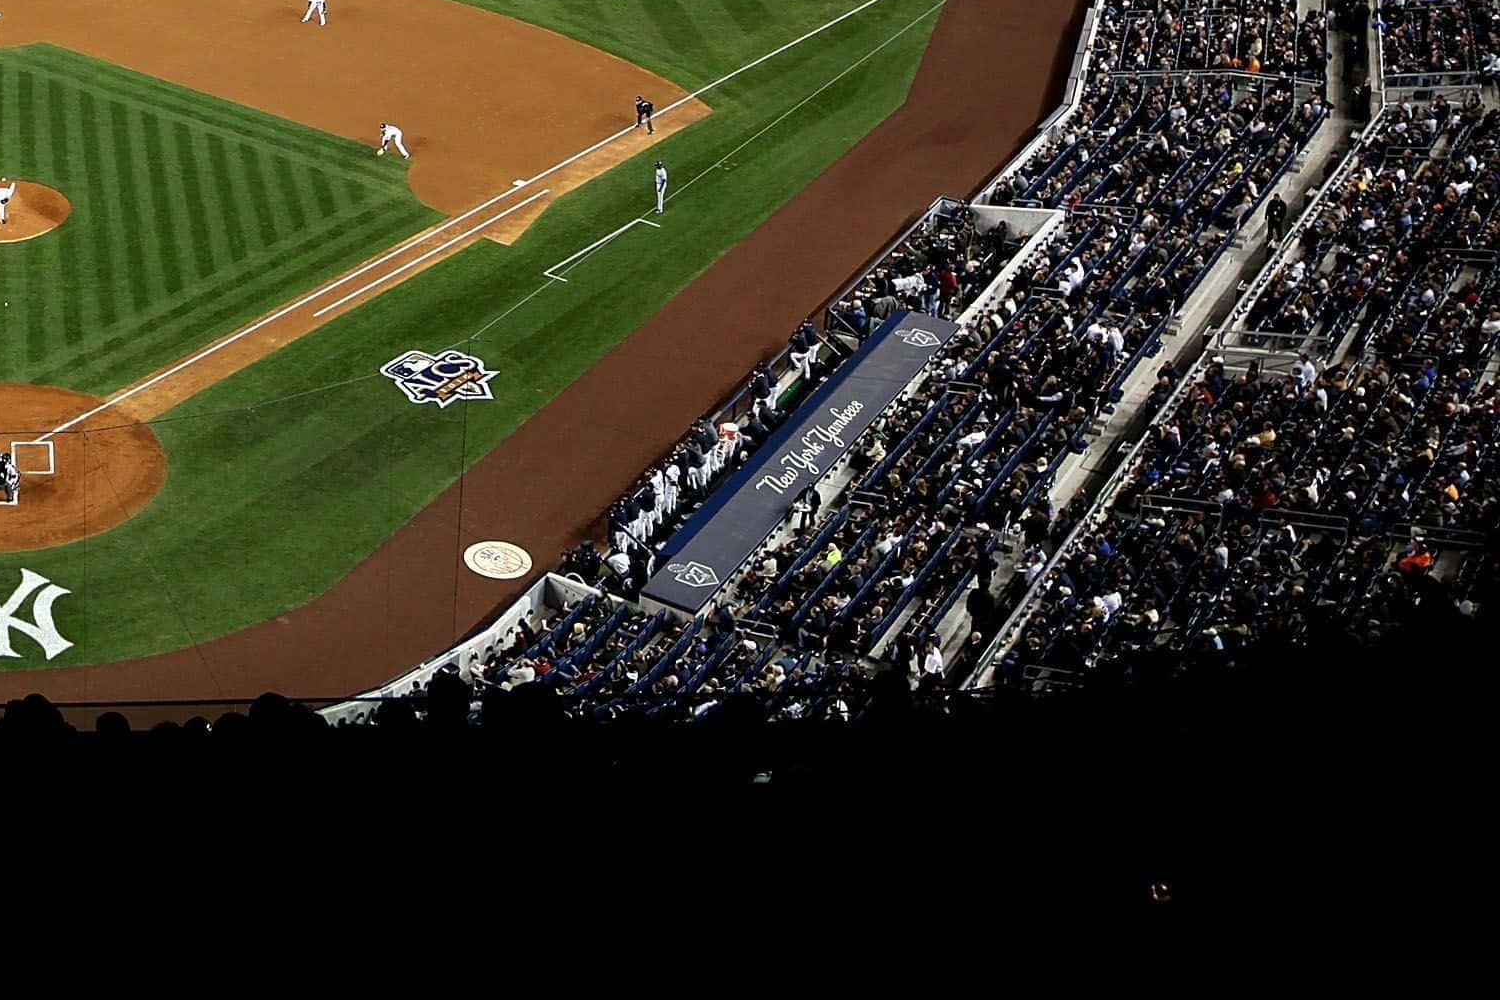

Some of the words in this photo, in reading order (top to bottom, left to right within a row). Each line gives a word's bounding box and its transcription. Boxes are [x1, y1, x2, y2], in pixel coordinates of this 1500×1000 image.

[755, 465, 800, 495] New
[780, 436, 824, 475] York
[808, 400, 864, 448] Yankees
